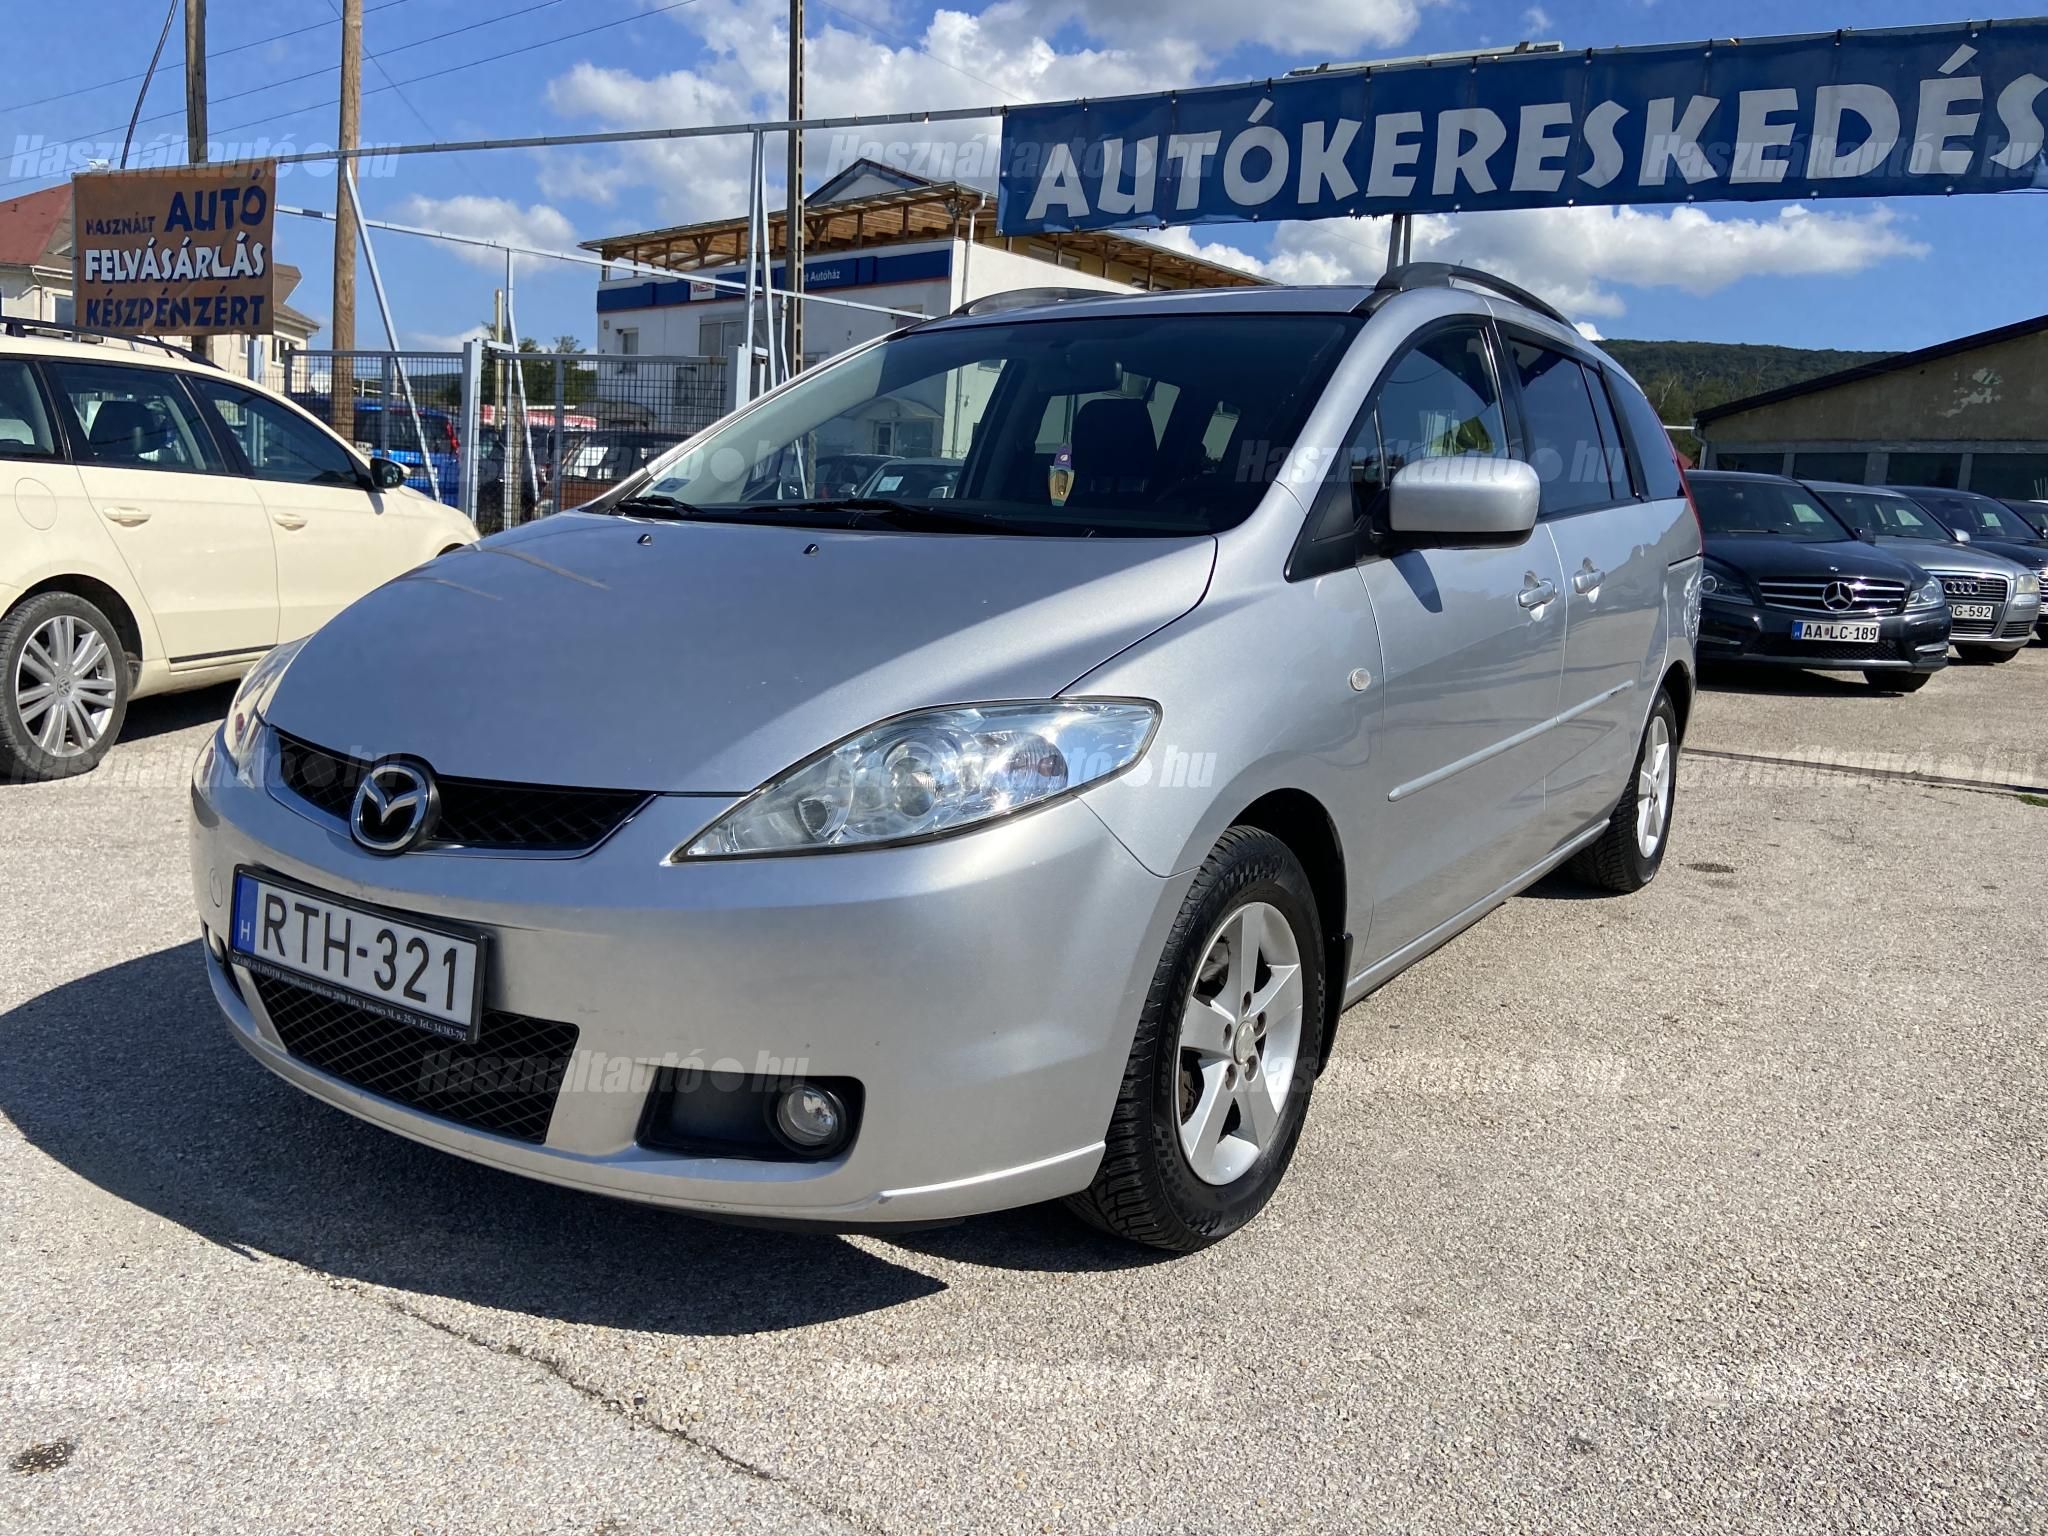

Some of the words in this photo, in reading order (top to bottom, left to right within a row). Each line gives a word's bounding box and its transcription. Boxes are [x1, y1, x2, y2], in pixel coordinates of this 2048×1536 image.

[1025, 43, 2048, 221] AUTÓKERESKEDÉS
[86, 212, 155, 236] HASZNÁLT
[164, 168, 266, 232] AUTÓ
[85, 231, 265, 282] FELVÁSÁRLÁS
[811, 269, 841, 282] Autóház
[86, 286, 265, 328] KÉSZPÉNZÉRT
[1829, 625, 1877, 641] LC-189
[241, 919, 251, 942] H
[263, 892, 458, 1011] RTH-321
